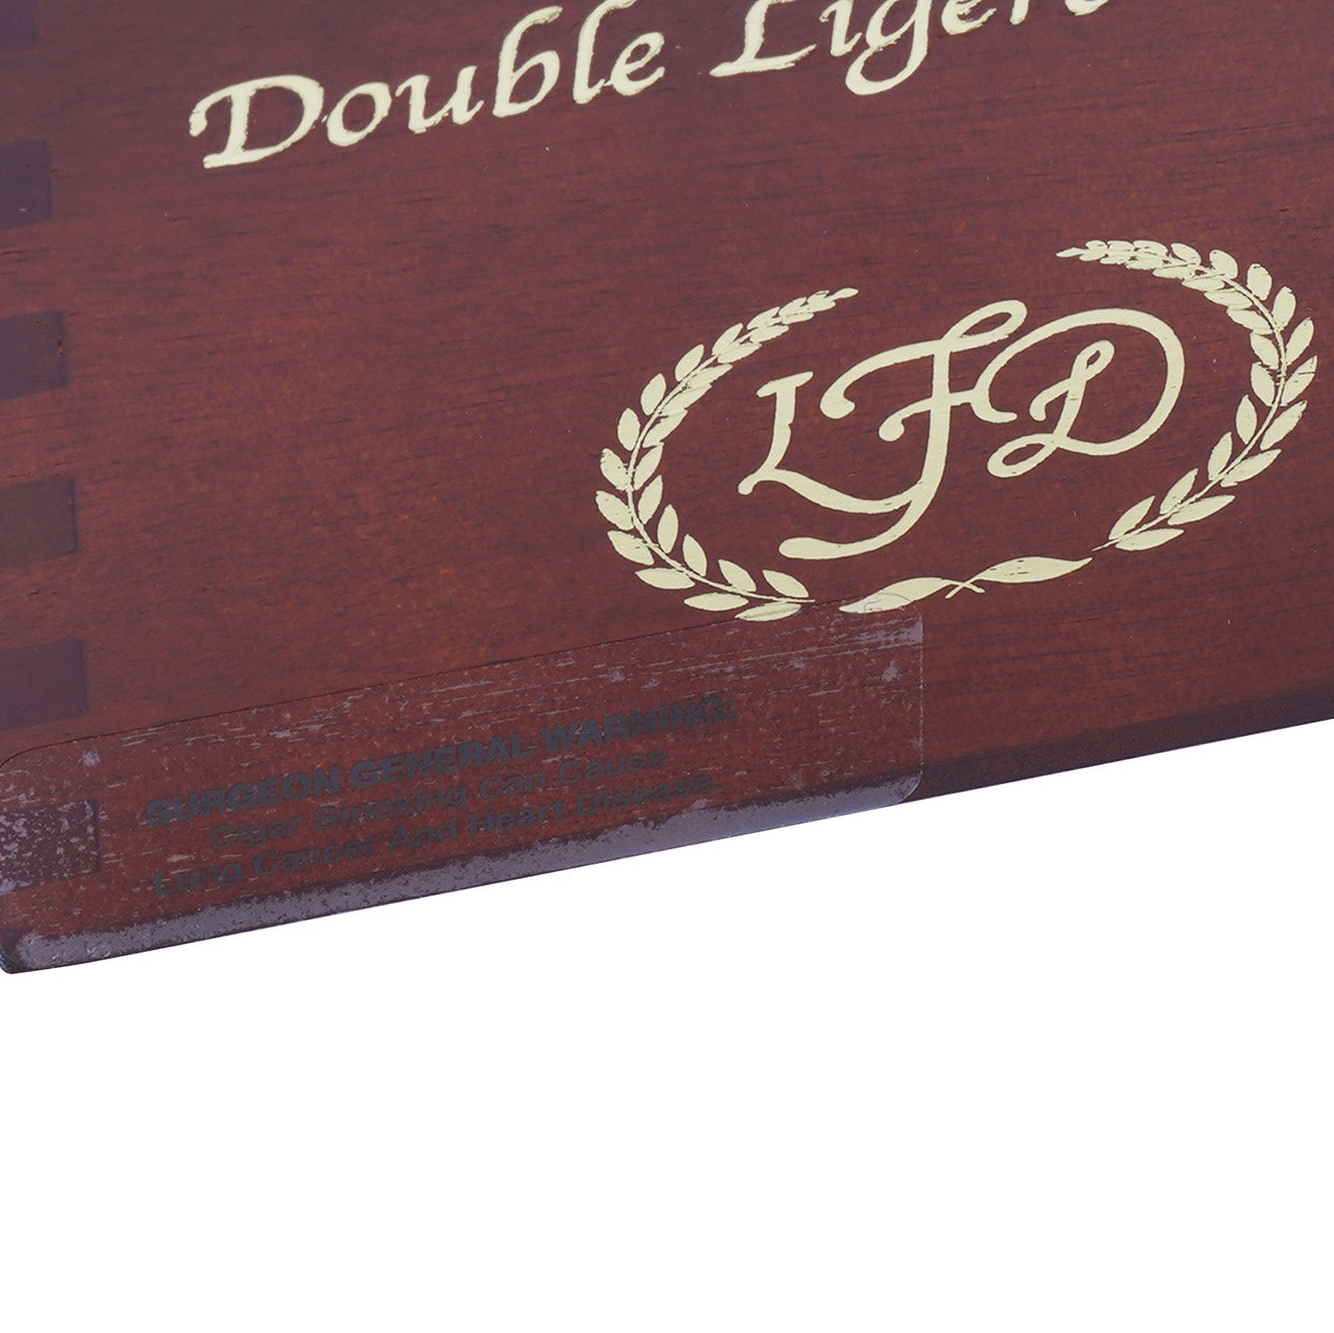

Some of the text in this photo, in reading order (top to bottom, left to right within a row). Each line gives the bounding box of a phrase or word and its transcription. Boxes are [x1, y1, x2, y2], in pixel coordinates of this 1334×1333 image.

[737, 299, 1186, 560] LFD
[144, 695, 738, 827] SURGEON GENERAL WARNING:
[209, 747, 668, 851] Cigar Smoking Can Cause
[153, 770, 724, 894] Lung Cancer And Heart Disease.
